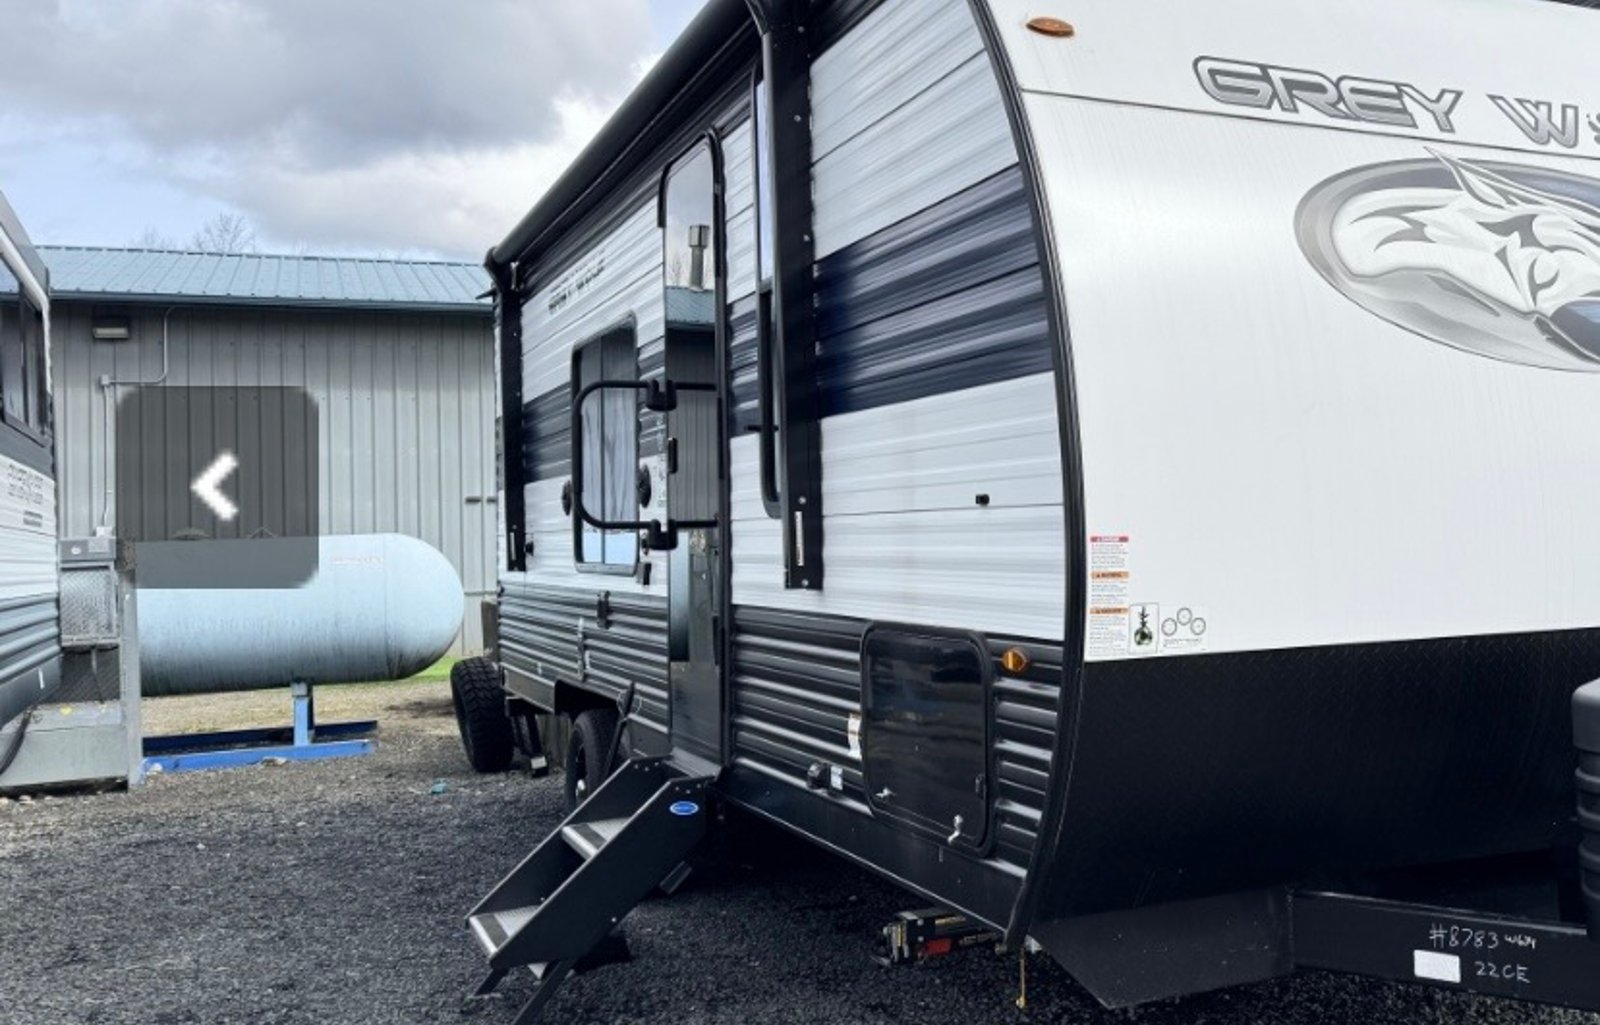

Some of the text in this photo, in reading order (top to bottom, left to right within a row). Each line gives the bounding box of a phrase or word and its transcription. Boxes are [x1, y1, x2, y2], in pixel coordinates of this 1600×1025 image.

[1192, 55, 1600, 149] GREY W
[1429, 922, 1499, 949] #8783
[1474, 961, 1530, 984] 22CE
